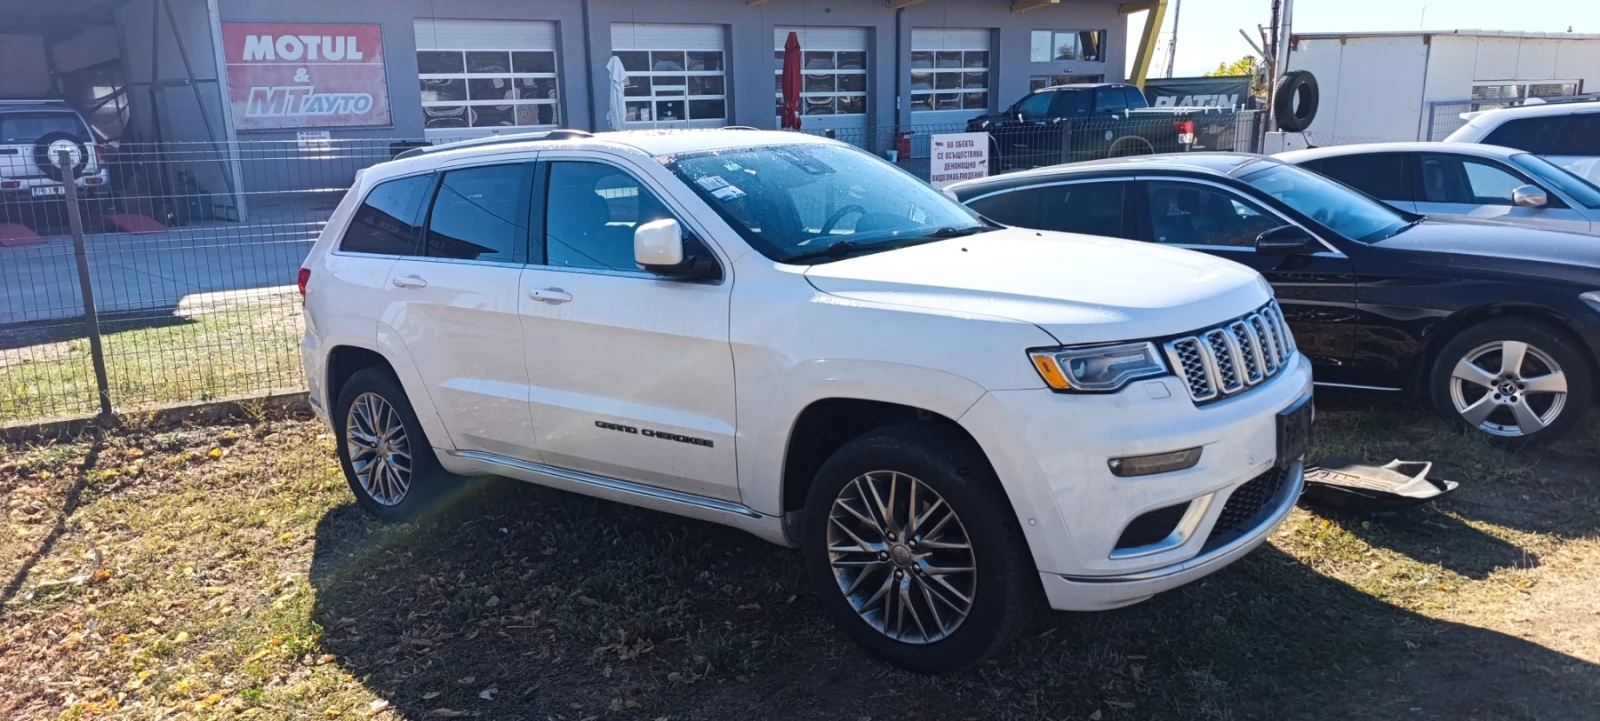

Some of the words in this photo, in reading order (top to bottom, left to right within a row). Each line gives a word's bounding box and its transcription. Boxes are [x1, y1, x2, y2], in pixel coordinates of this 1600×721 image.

[242, 35, 363, 61] MOTUL
[293, 67, 310, 83] &
[955, 140, 974, 148] ОБЕКТА
[937, 152, 944, 160] СЕ
[945, 150, 983, 159] ОСЪЩЕСТВЯВА
[944, 161, 976, 171] ДЕНОНОЩНО
[595, 420, 639, 434] GRAND
[641, 428, 714, 448] CHEROKEE
